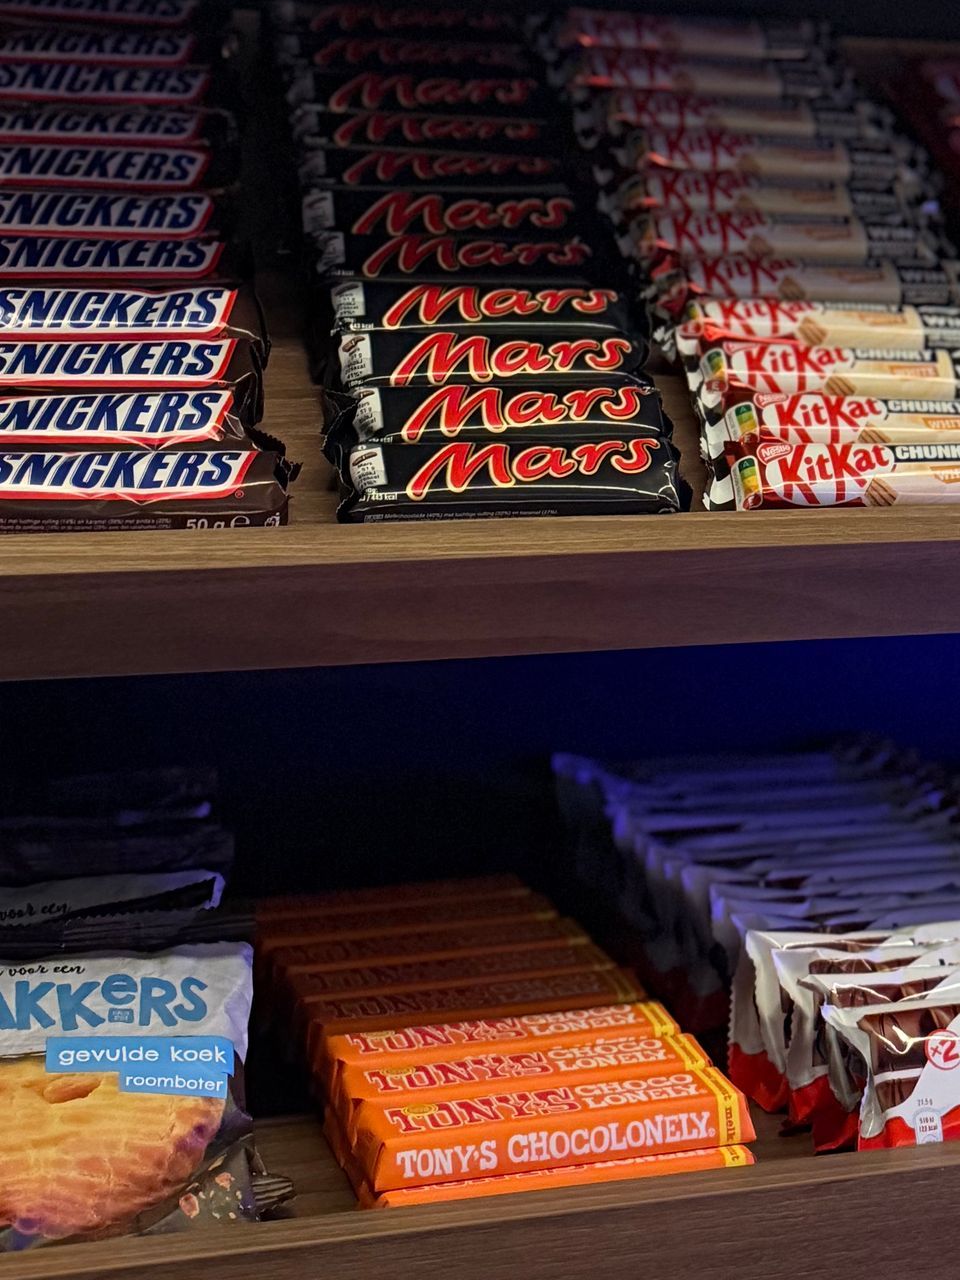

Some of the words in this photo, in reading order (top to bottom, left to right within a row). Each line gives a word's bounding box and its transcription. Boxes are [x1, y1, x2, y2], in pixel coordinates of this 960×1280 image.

[352, 192, 574, 236] Mars
[362, 234, 592, 278] Mars
[382, 283, 618, 330] Mars
[717, 295, 816, 337] KitKat
[390, 332, 632, 387] Mars
[744, 342, 850, 394] KitKat
[401, 384, 647, 444] Mars
[774, 394, 882, 444] KitKat
[406, 438, 660, 501] Mars
[777, 442, 890, 505] KitKat
[9, 965, 48, 976] voor
[53, 964, 86, 975] een
[58, 1046, 159, 1066] gevulde
[170, 1044, 227, 1064] koek
[364, 1052, 554, 1093] TONY'S
[547, 1039, 663, 1060] CHOCO
[125, 1073, 224, 1092] roomboter
[384, 1086, 582, 1134] TONY'S
[575, 1073, 693, 1096] CHOCO
[724, 1106, 735, 1142] melk
[397, 1139, 498, 1179] TONY'S
